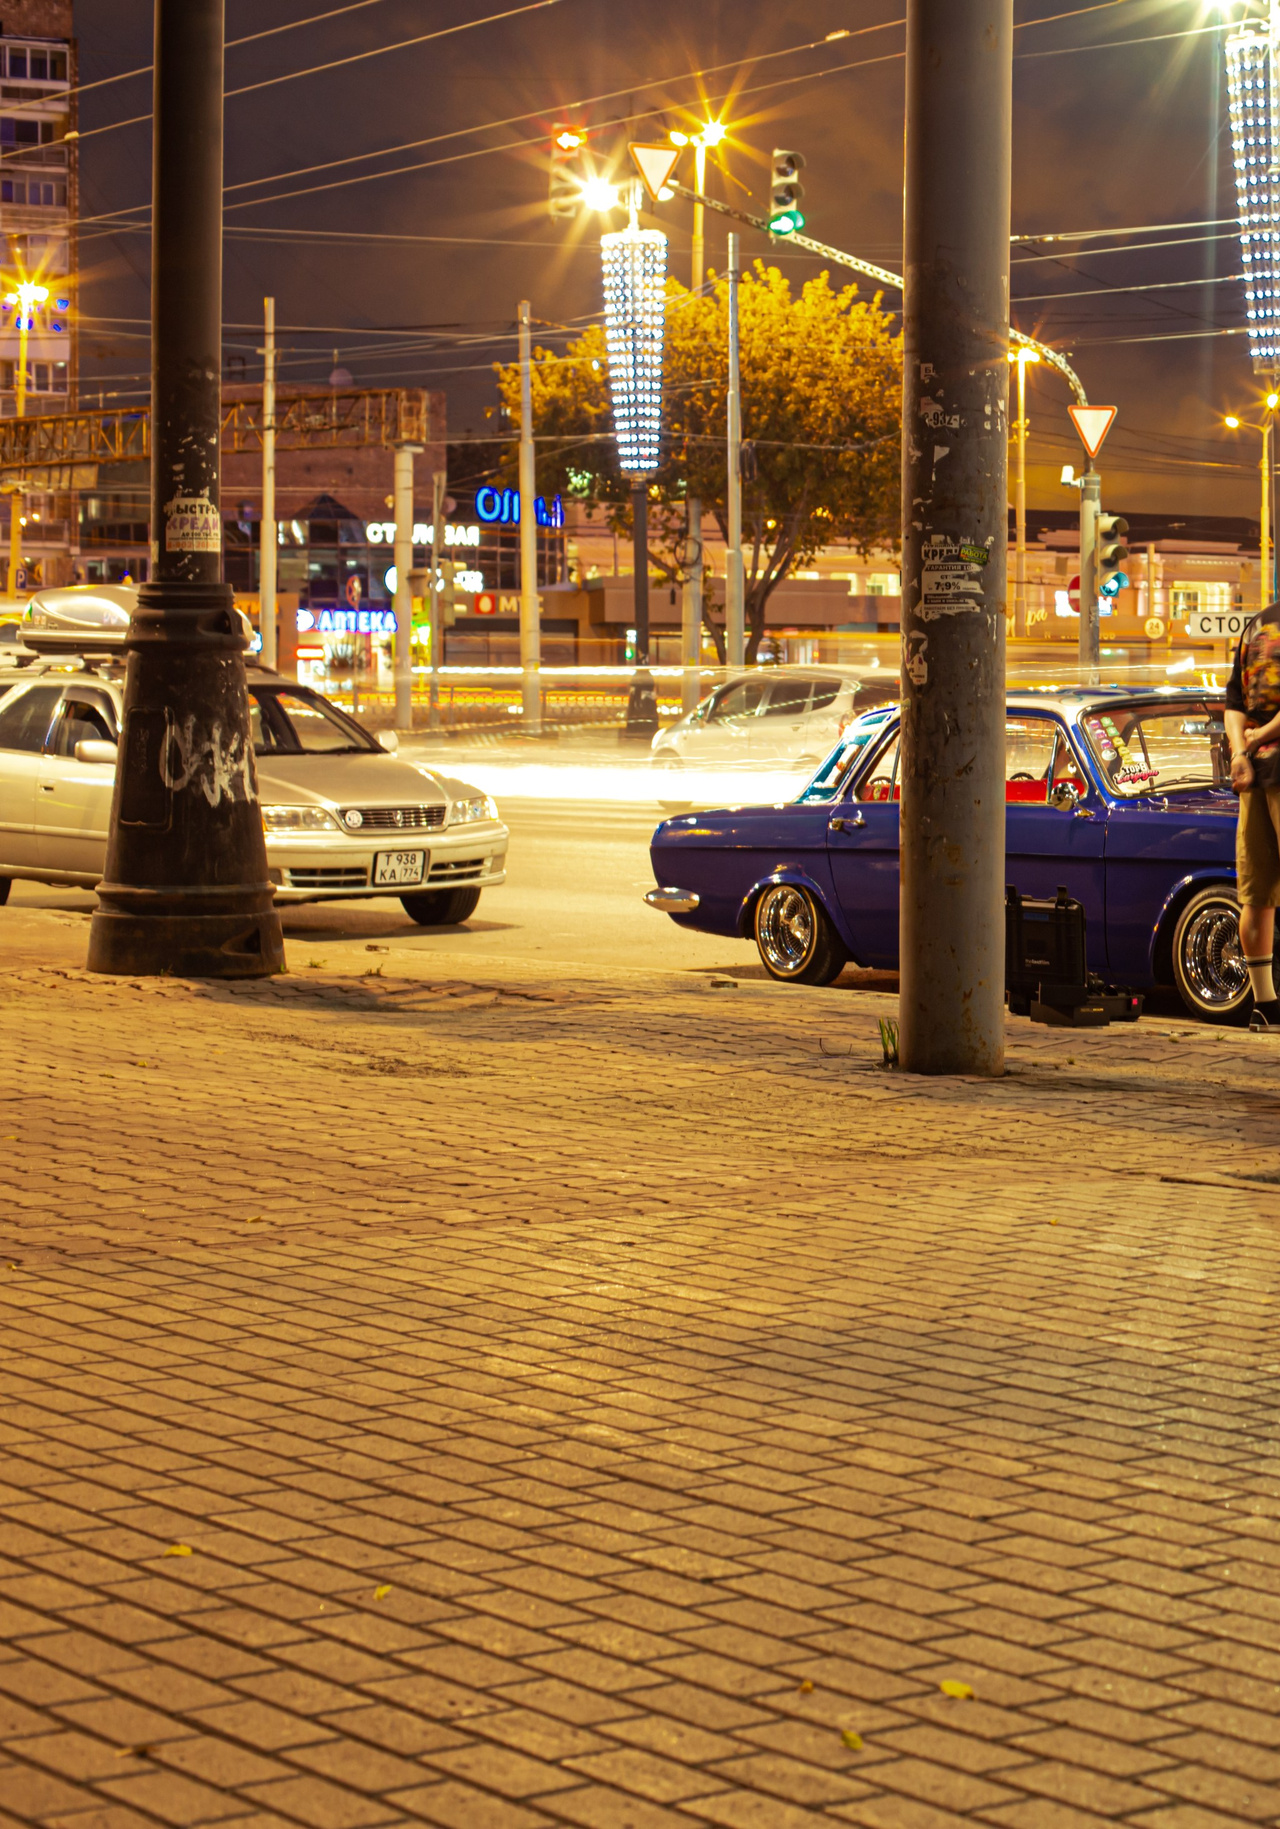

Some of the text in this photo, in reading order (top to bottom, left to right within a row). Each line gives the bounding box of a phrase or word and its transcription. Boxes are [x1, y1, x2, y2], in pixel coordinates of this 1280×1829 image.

[960, 548, 988, 560] РАБОТА
[934, 581, 961, 592] 7,9%
[317, 609, 398, 633] АПТЕКА
[1149, 622, 1160, 630] 24
[396, 853, 416, 865] 938
[380, 868, 418, 880] КА 774
